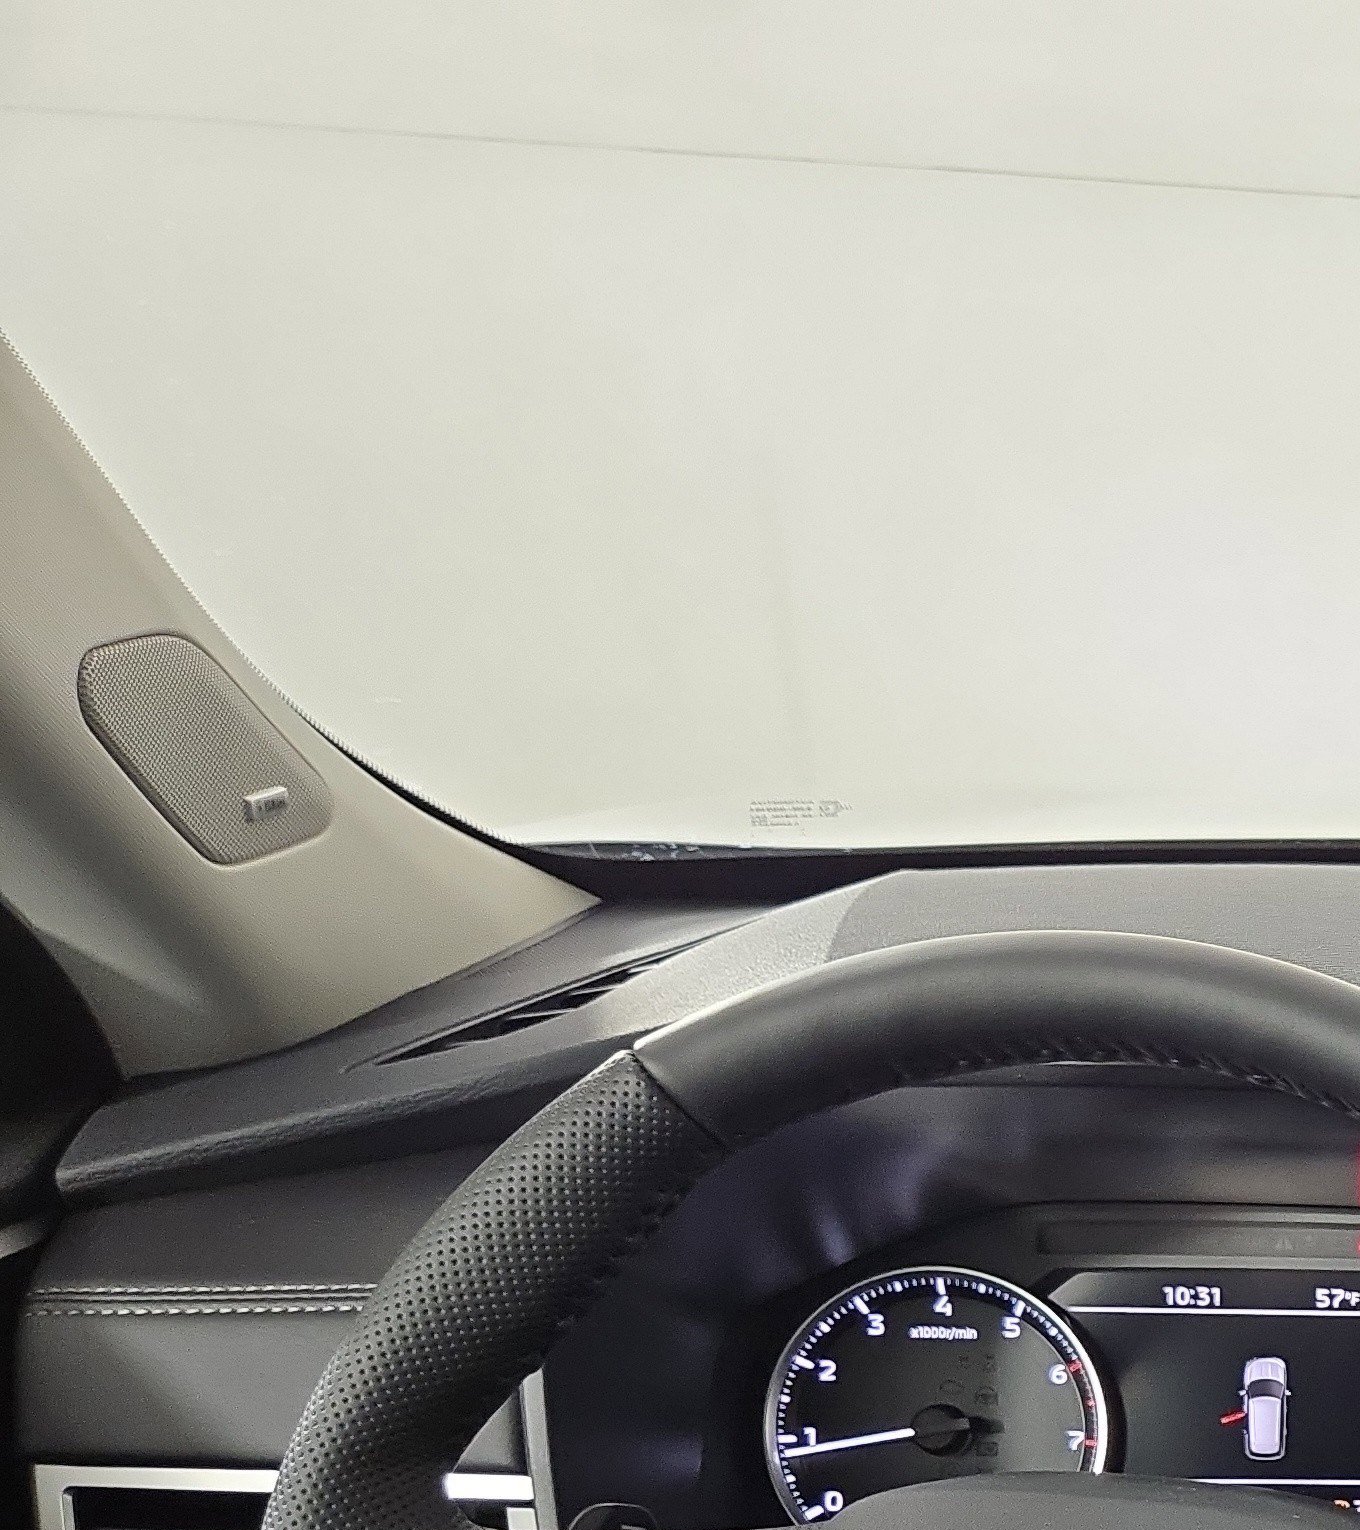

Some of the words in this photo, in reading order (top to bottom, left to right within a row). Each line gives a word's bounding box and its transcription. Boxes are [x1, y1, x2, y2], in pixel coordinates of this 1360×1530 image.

[933, 1296, 952, 1316] 4
[1162, 1286, 1221, 1307] 10:31
[867, 1314, 885, 1335] 3
[1002, 1317, 1020, 1338] 5
[818, 1360, 836, 1381] 2
[1050, 1364, 1068, 1384] 6
[803, 1428, 817, 1446] 1
[1065, 1431, 1084, 1451] 7
[825, 1491, 843, 1511] 0
